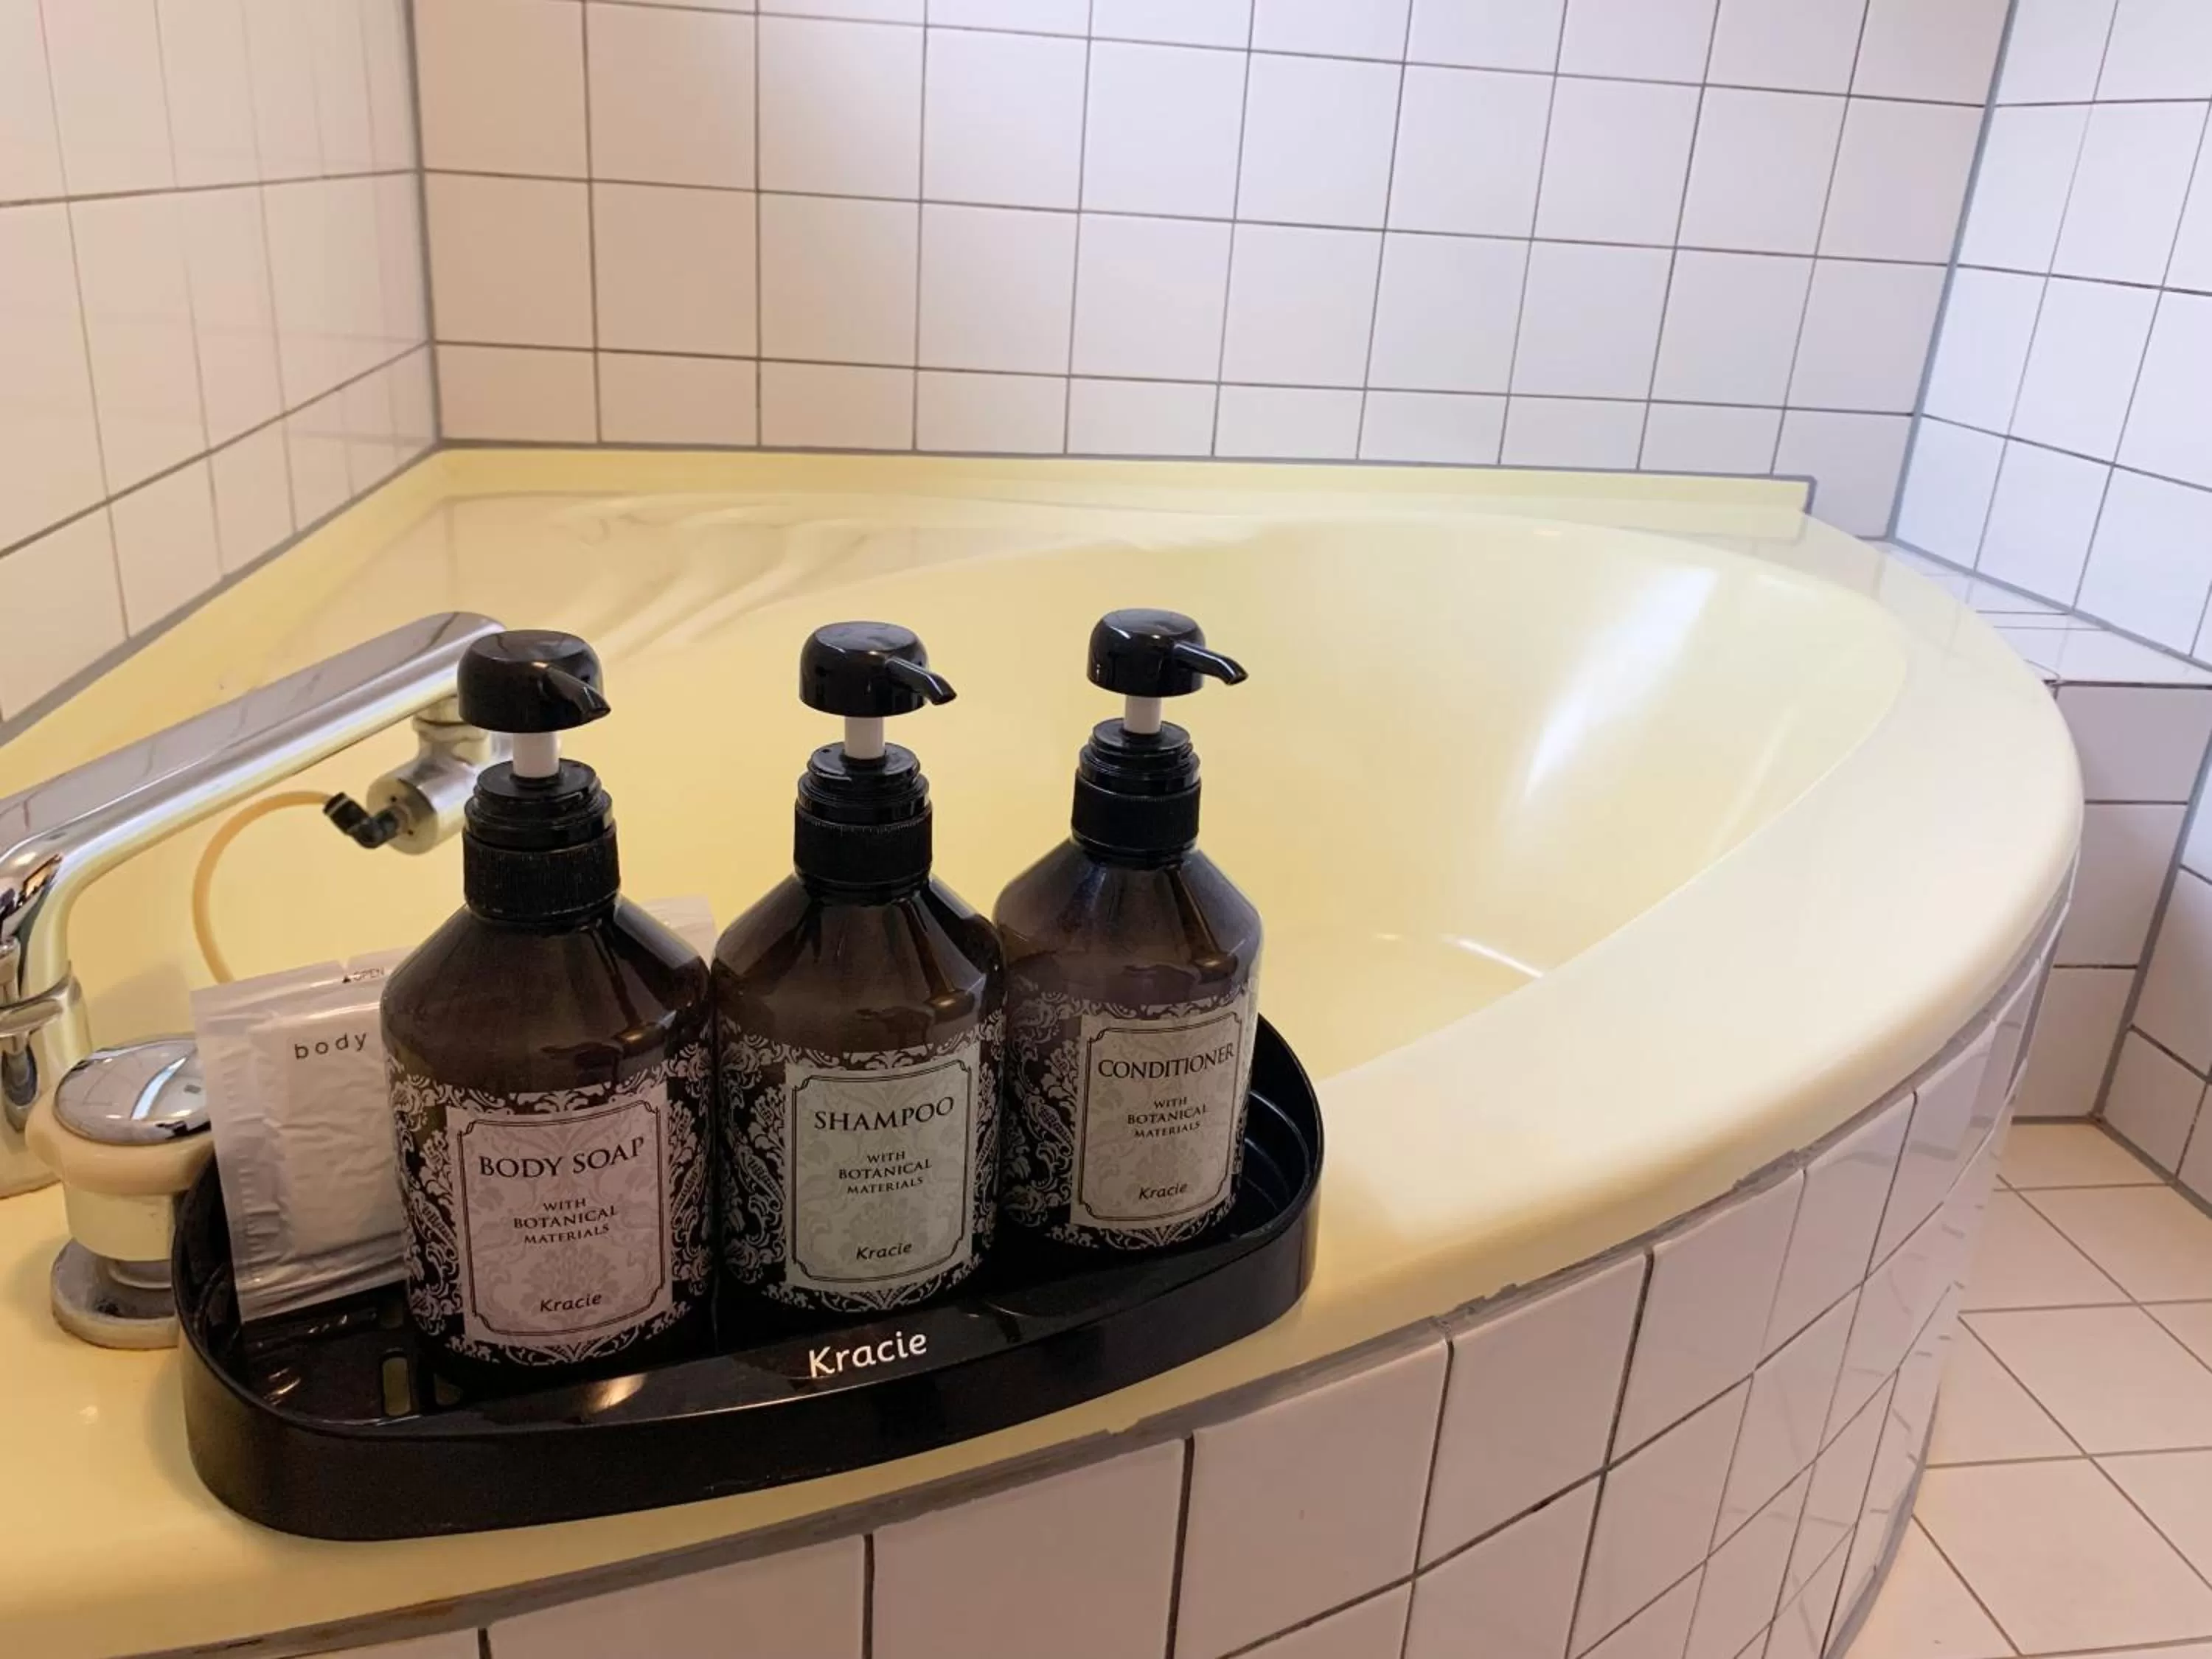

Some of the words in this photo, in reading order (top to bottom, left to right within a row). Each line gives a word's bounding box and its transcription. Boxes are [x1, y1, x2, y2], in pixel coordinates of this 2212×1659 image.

[295, 1032, 366, 1060] body
[1098, 1042, 1234, 1079] CONDITIONER
[1153, 1096, 1188, 1110] WITH
[814, 1096, 954, 1131] SHAMPOO
[1127, 1104, 1207, 1124] BOTANICAL
[1134, 1121, 1201, 1138] MATERIALS
[479, 1155, 564, 1178] BODY
[572, 1136, 644, 1174] SOAP
[866, 1150, 906, 1164] WITH
[838, 1158, 933, 1180] BOTANICAL
[846, 1177, 924, 1194] MATERIALS
[1138, 1183, 1189, 1200] Kracie
[542, 1197, 587, 1211] WITH
[513, 1205, 618, 1229] BOTANICAL
[524, 1222, 610, 1244] MATERIALS
[855, 1242, 913, 1260] Kracie
[539, 1293, 602, 1312] Kracie
[807, 1331, 928, 1379] Kracie
